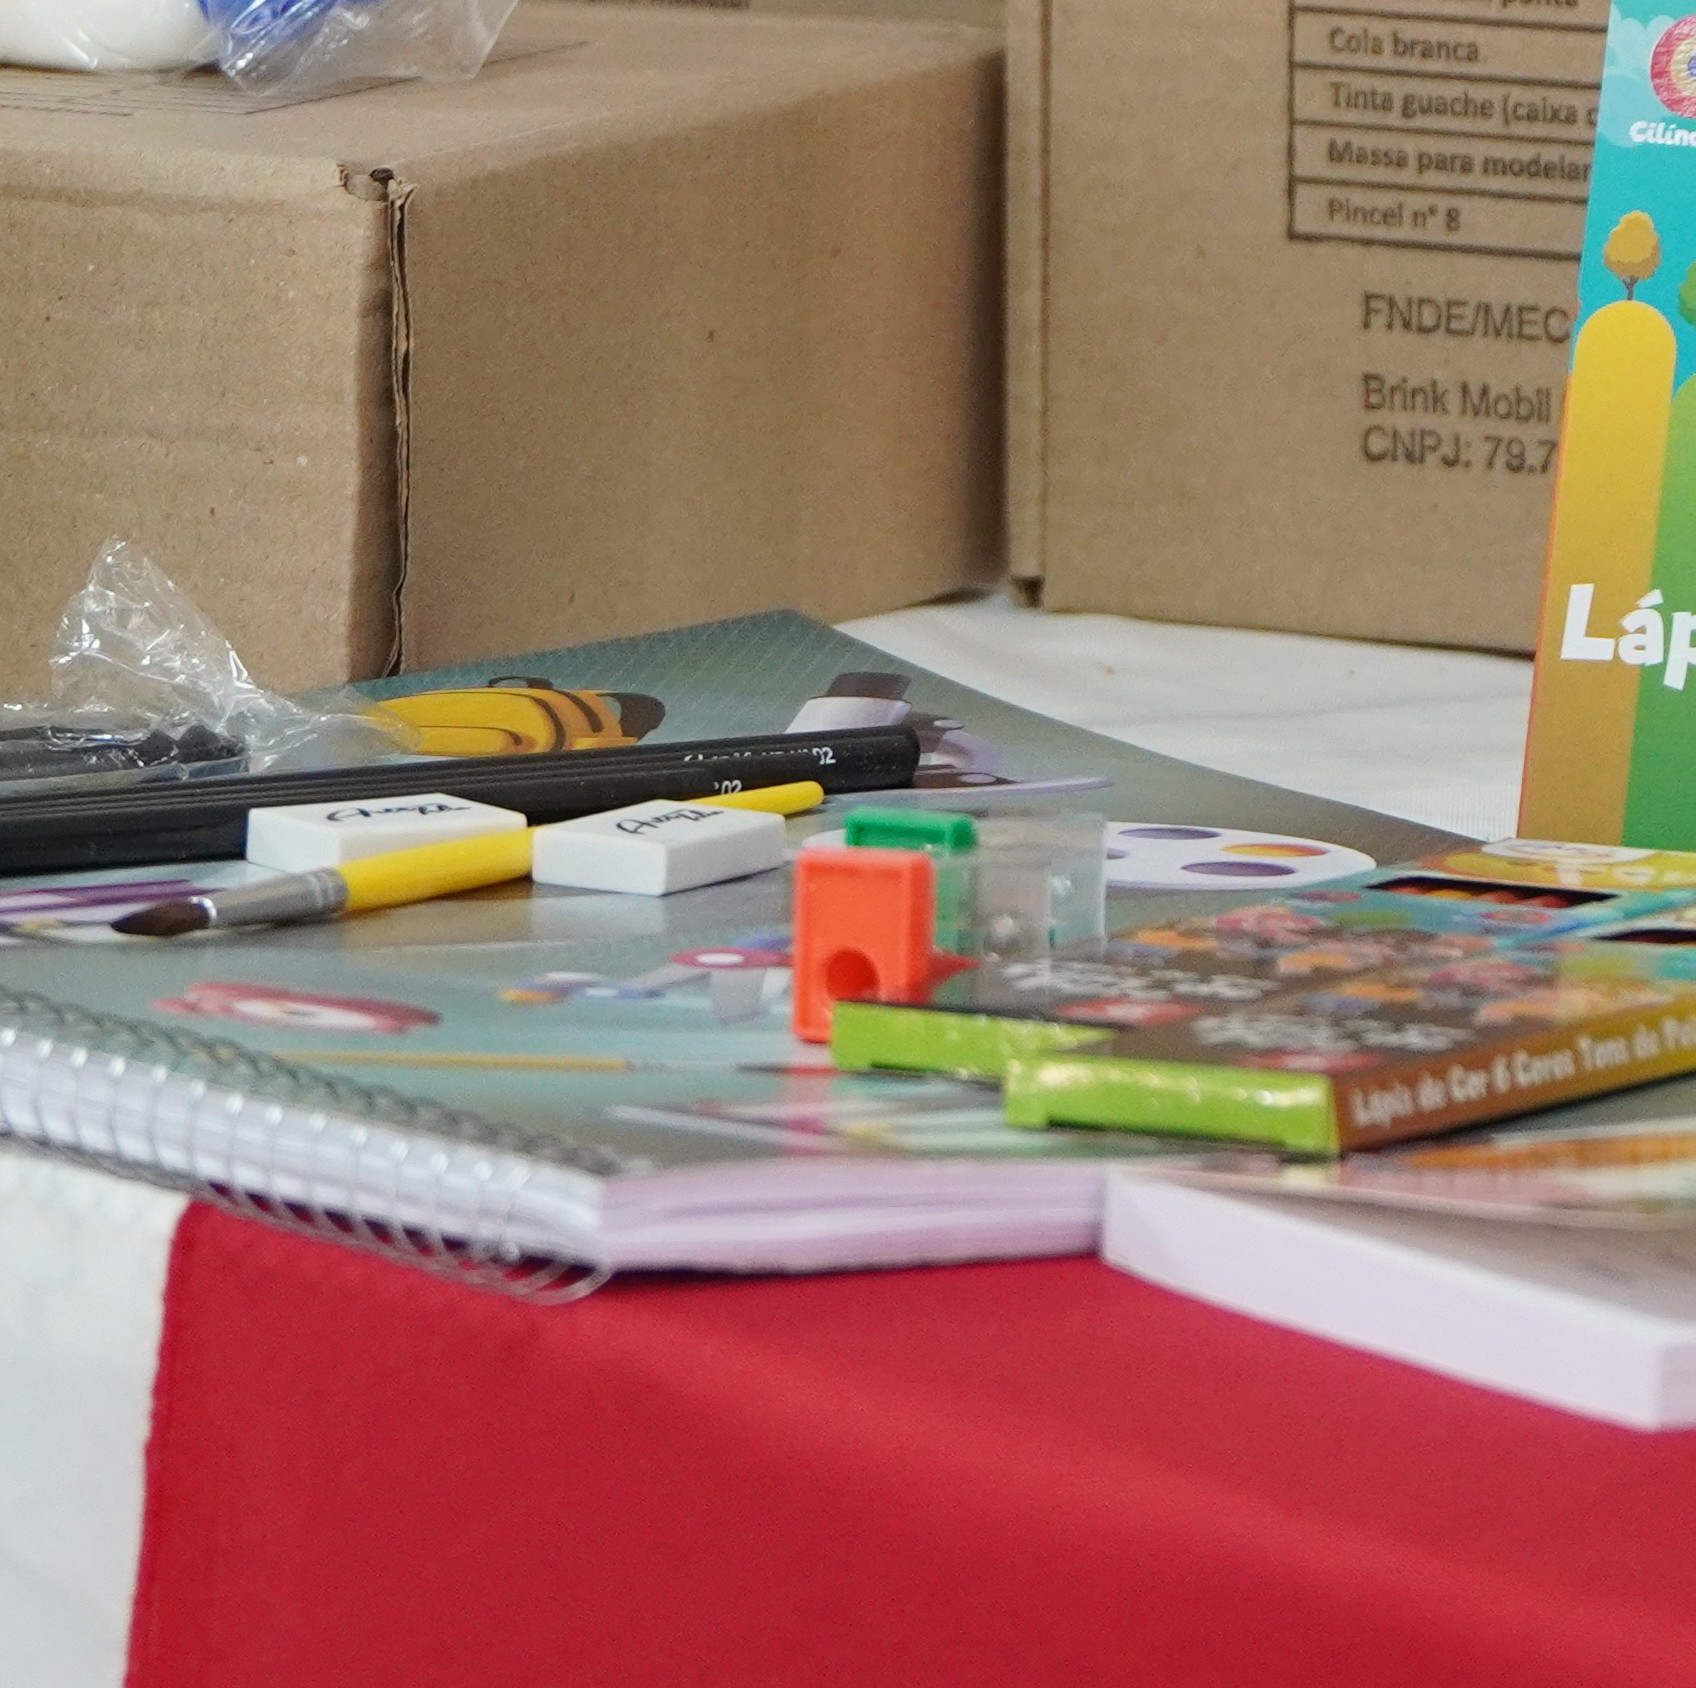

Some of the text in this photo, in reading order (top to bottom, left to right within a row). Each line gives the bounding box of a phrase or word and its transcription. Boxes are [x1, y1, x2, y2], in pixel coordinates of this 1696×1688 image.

[1328, 27, 1480, 63] Cola branca
[1328, 82, 1495, 122] Tinta guache
[1328, 140, 1592, 183] Massa para modelar
[1327, 199, 1462, 231] Pincel 8
[1361, 290, 1570, 346] FNDE/MEC
[1362, 372, 1449, 418] Brink
[1361, 424, 1472, 470] CNPJ:
